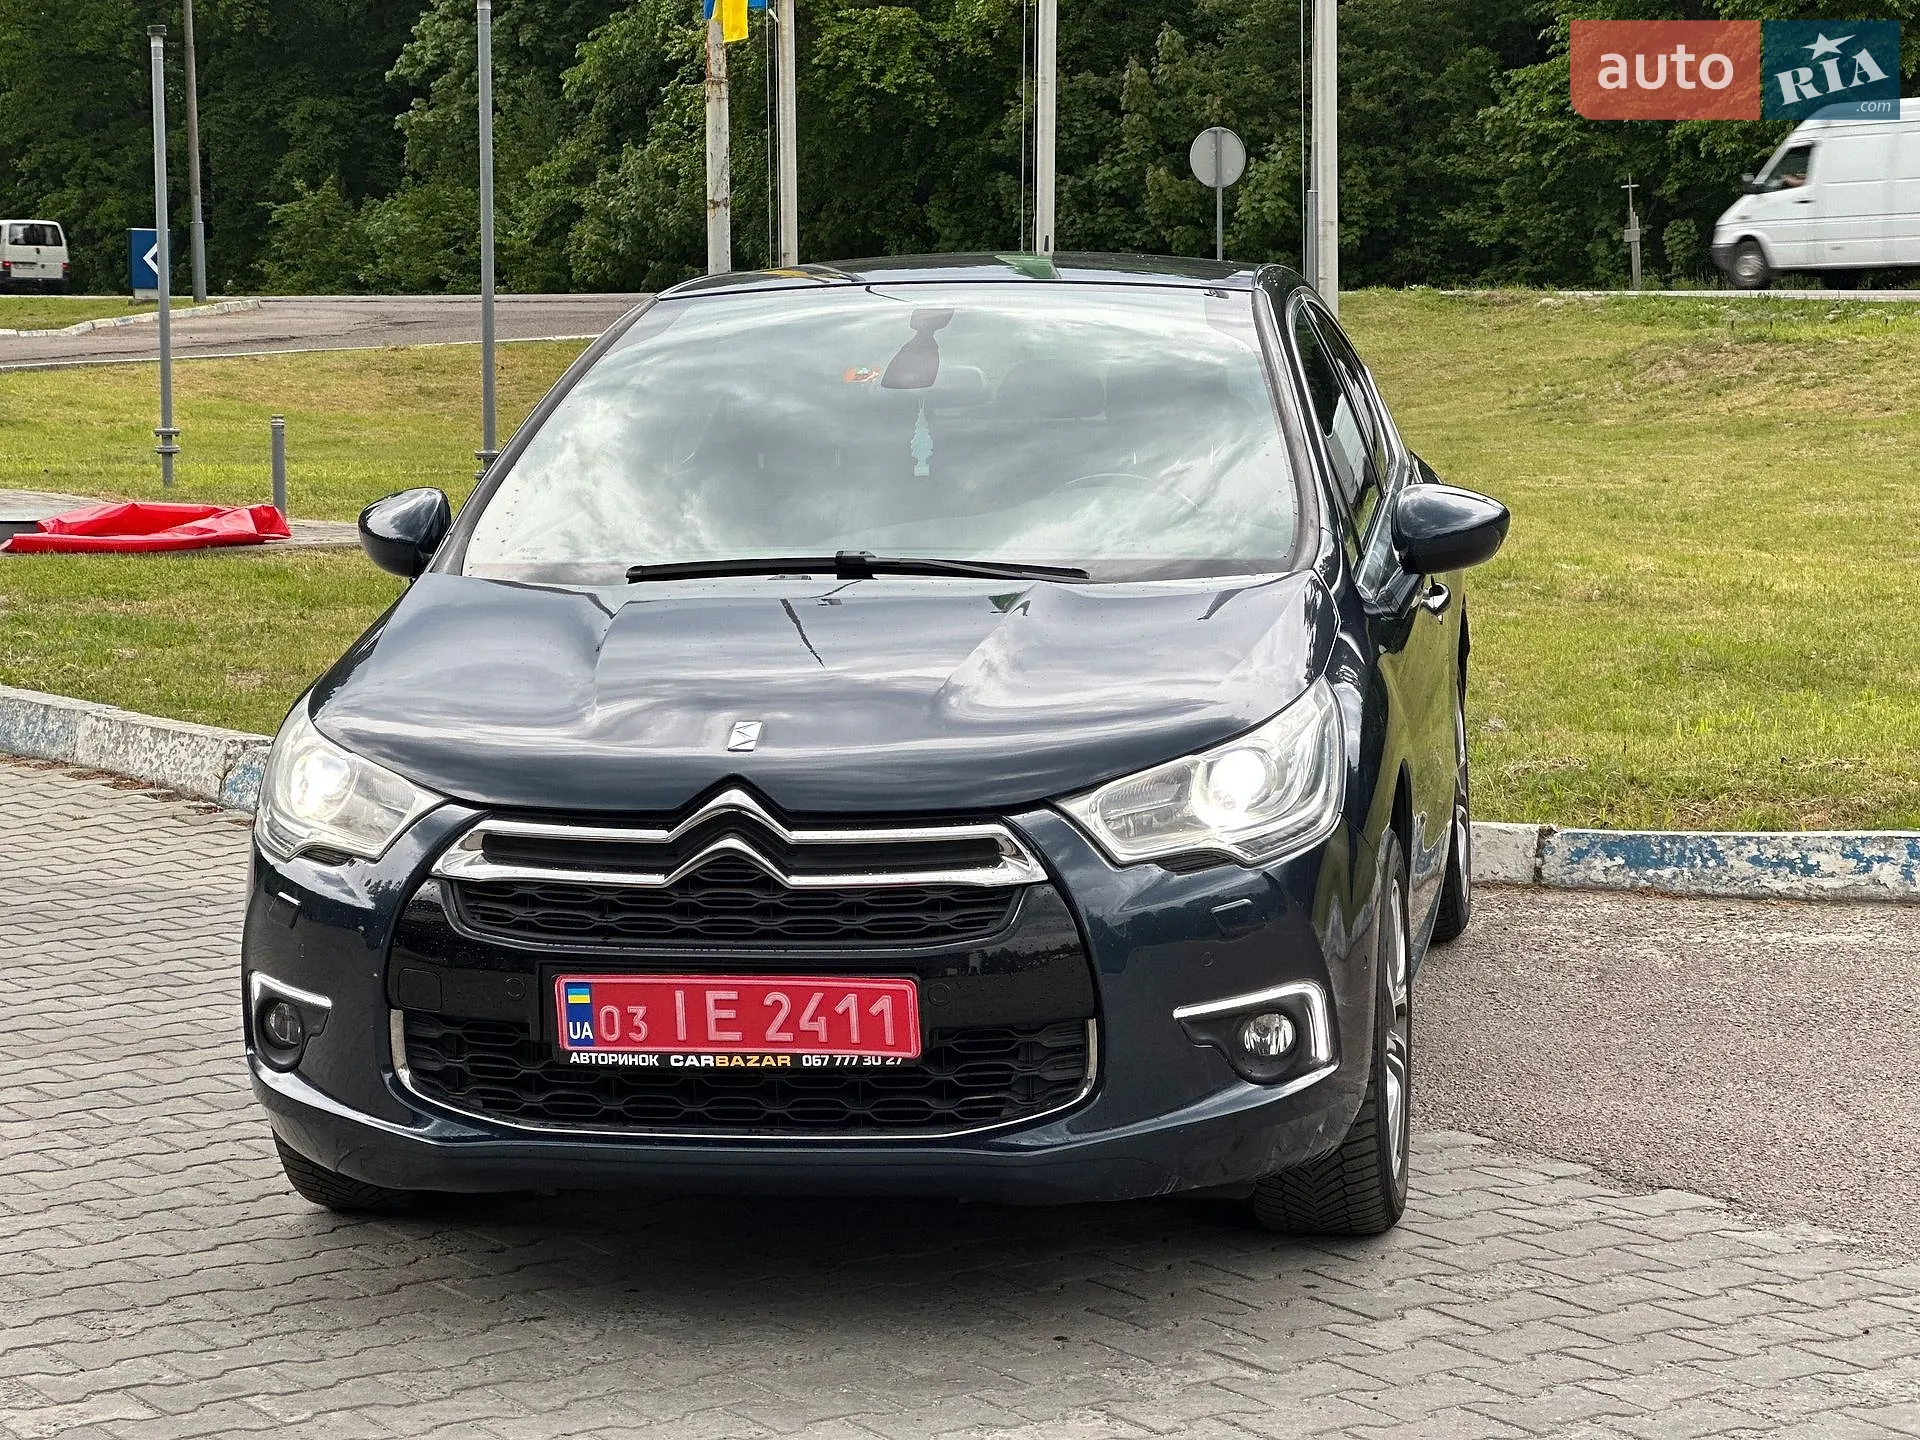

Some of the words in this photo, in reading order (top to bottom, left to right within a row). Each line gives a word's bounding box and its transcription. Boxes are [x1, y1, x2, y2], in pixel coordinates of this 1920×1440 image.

[599, 1005, 648, 1042] 03
[674, 989, 743, 1042] IE
[763, 991, 896, 1046] 2411
[569, 1021, 594, 1040] UA
[569, 1051, 660, 1067] АВТОРИНОК
[669, 1054, 792, 1067] CARBAZAR
[802, 1054, 830, 1067] 067
[833, 1055, 859, 1066] 777
